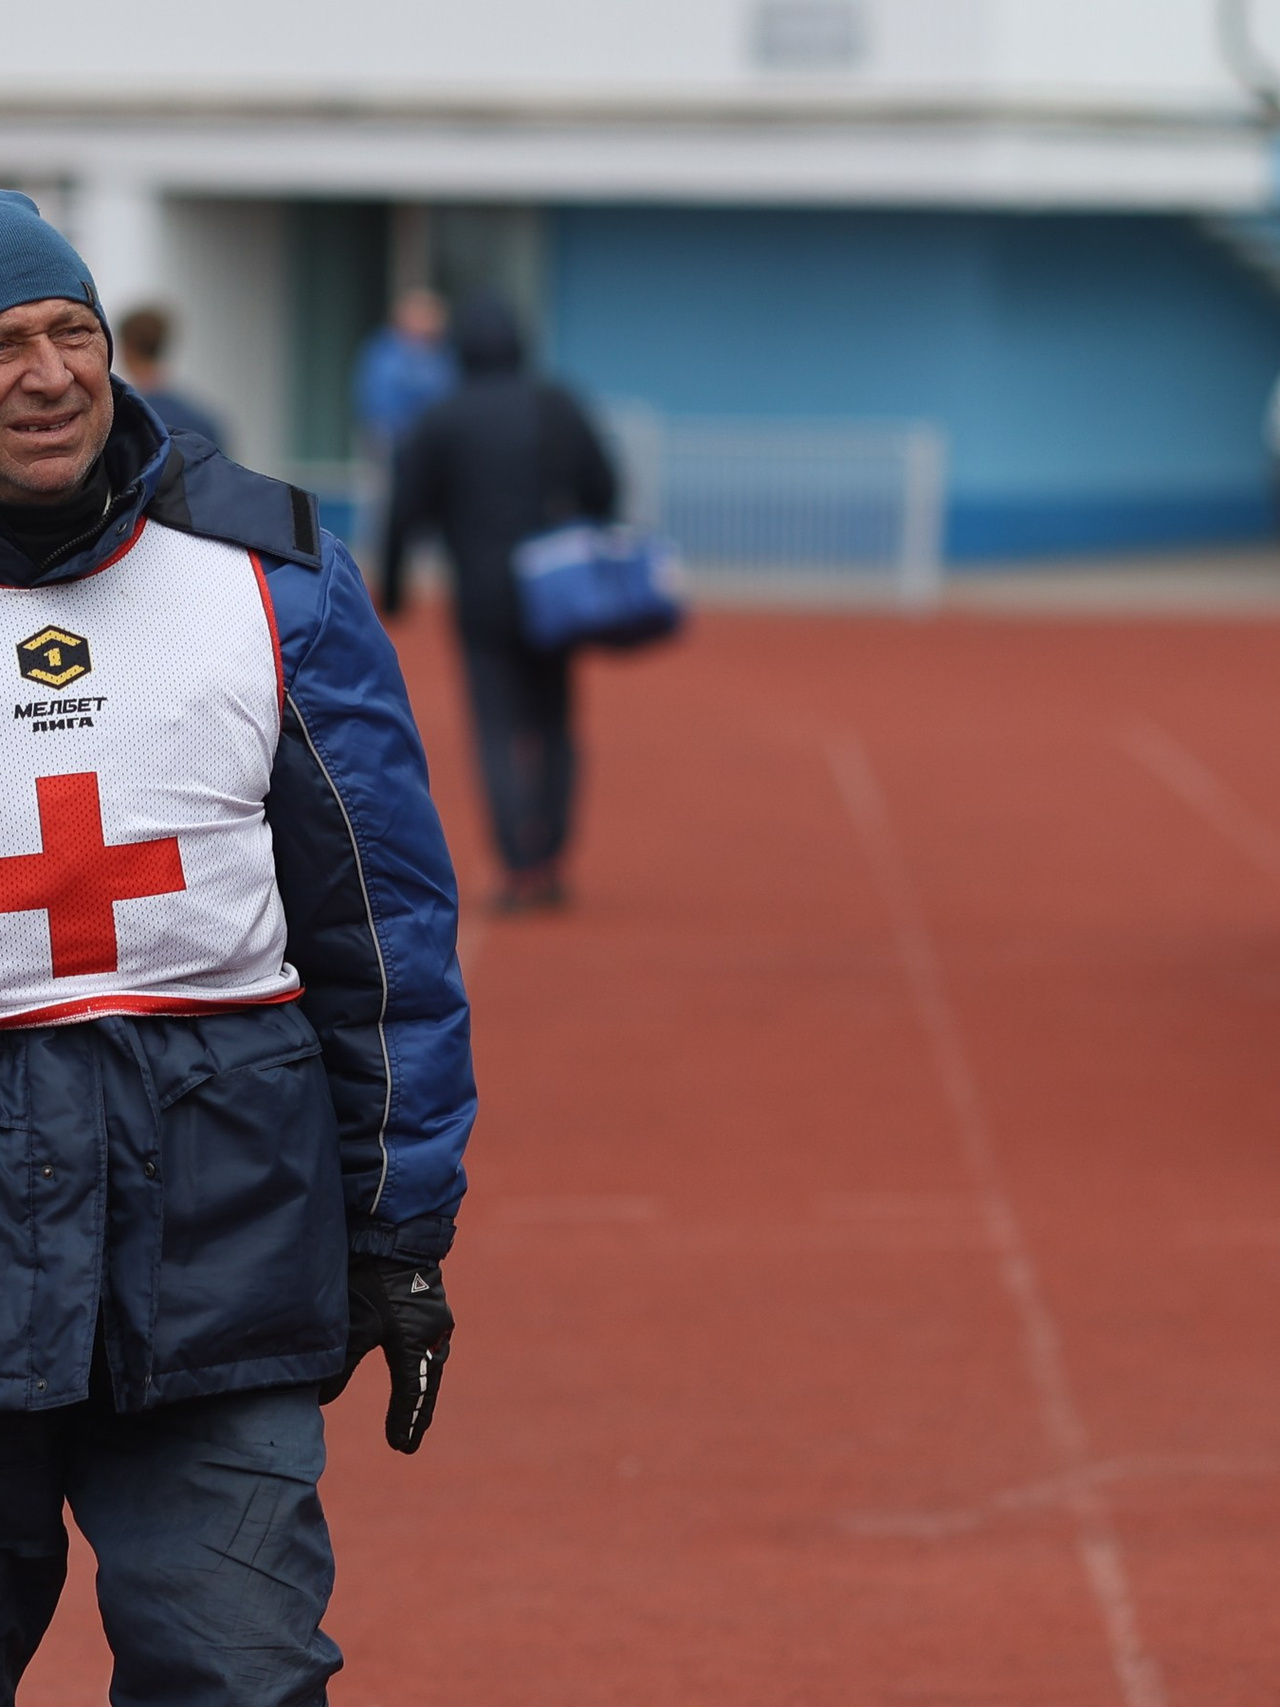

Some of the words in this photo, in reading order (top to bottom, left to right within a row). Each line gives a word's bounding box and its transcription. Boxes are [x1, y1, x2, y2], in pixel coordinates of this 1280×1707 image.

[43, 647, 62, 667] 1
[14, 697, 108, 720] МЕЛБЕТ
[32, 716, 94, 732] ЛИГА
